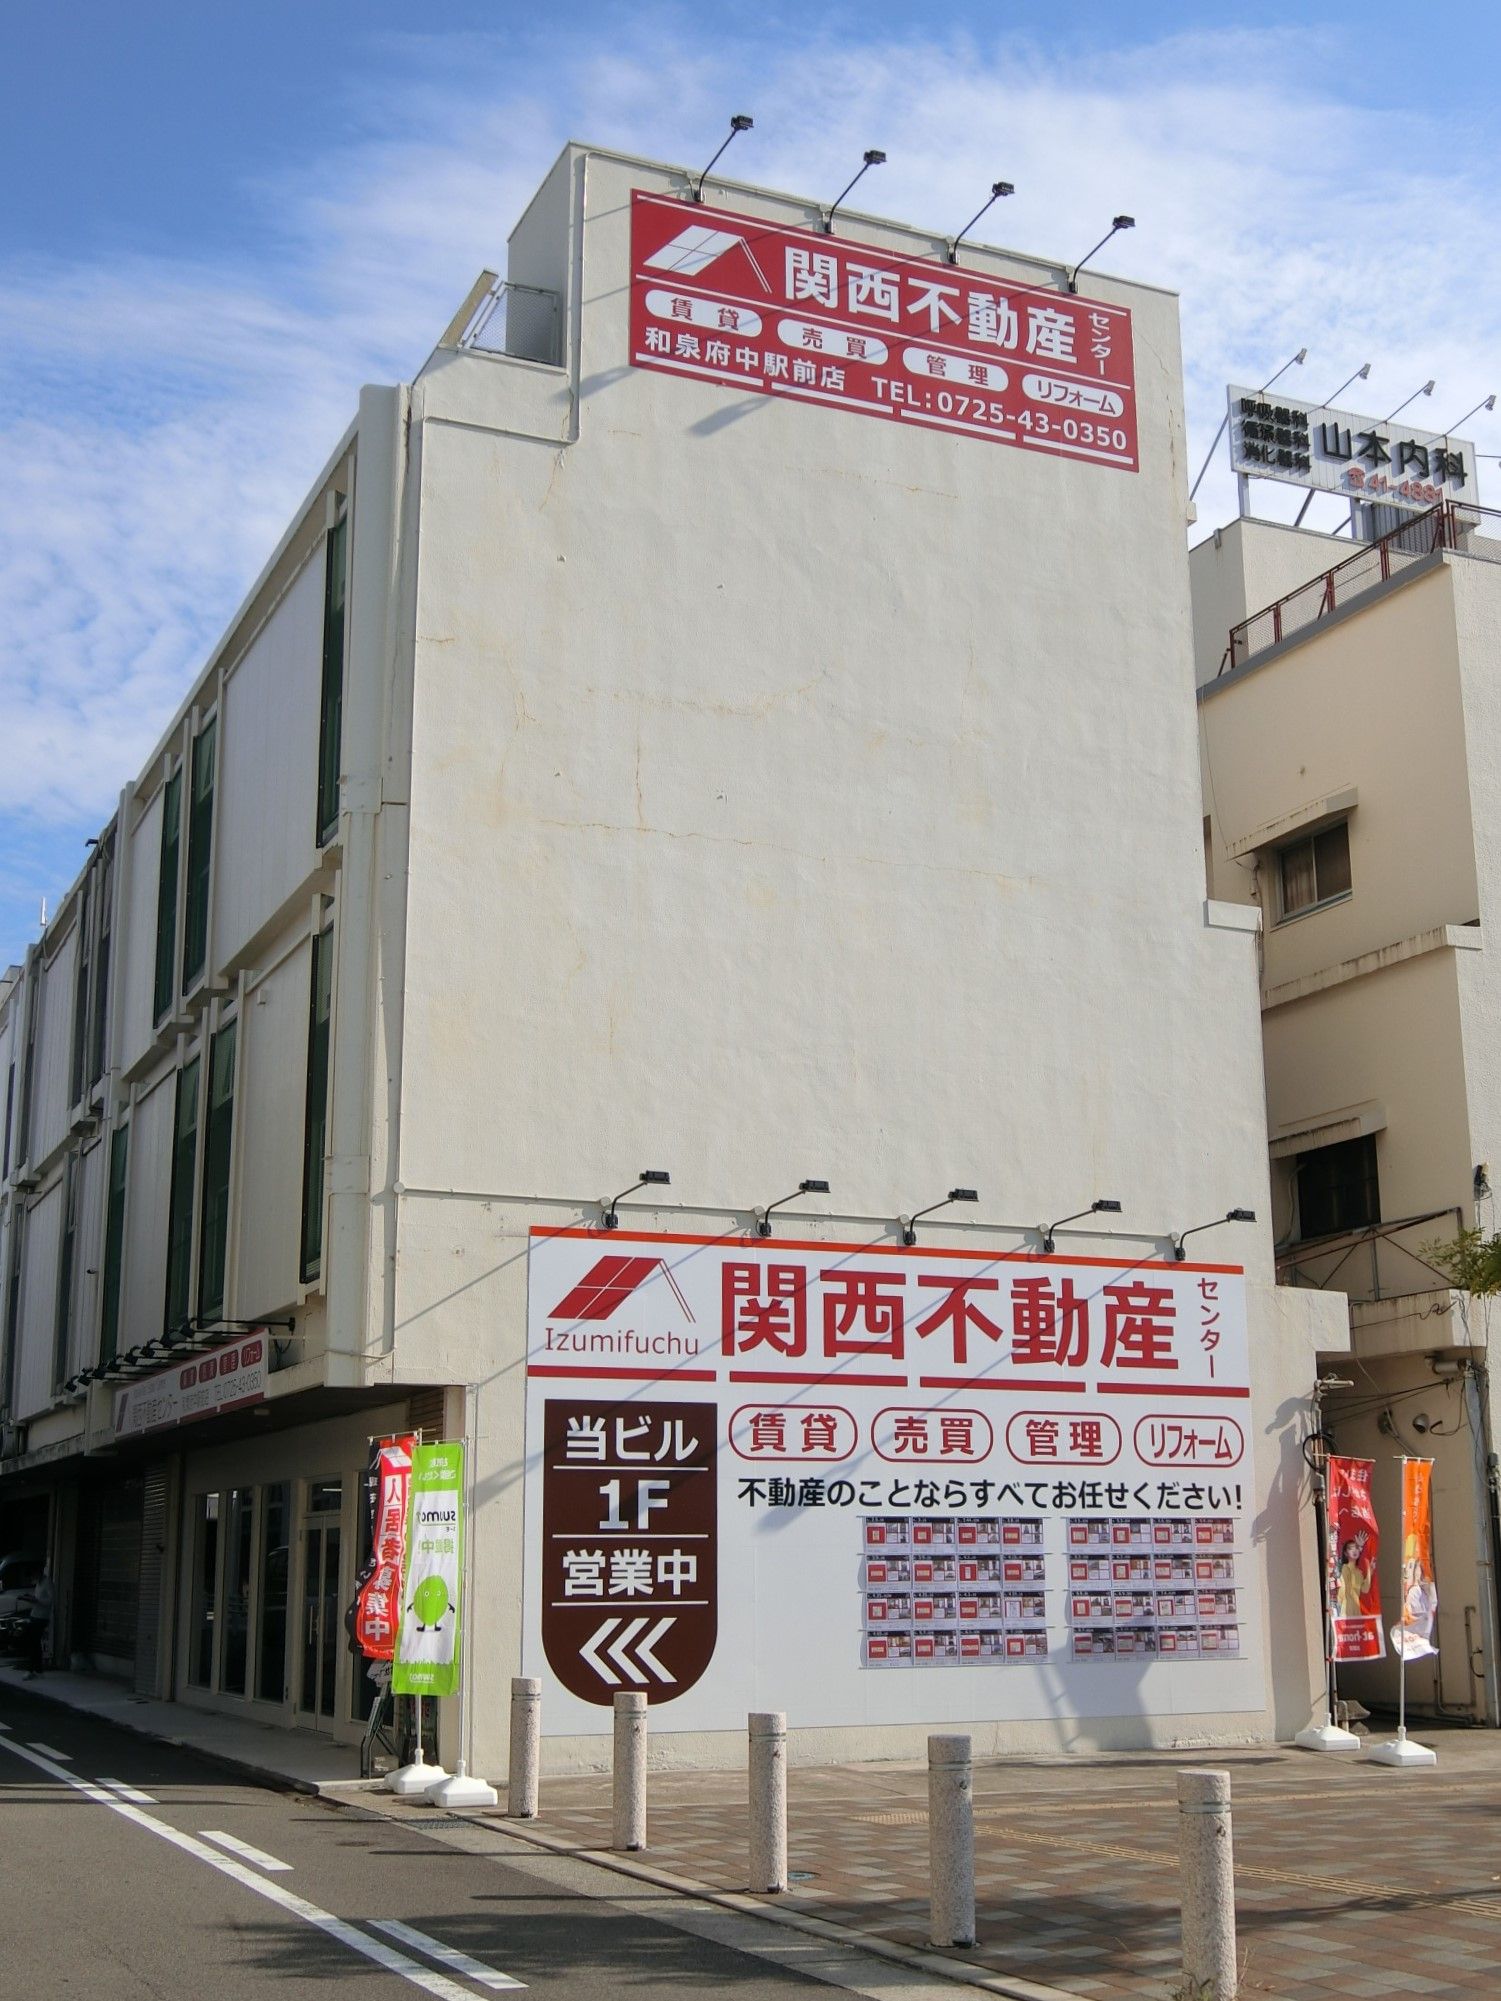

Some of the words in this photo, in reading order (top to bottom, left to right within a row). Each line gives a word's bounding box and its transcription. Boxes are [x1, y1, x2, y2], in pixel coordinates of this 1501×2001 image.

[670, 297, 740, 331] 賃貸
[784, 245, 1078, 364] 関西不動産
[645, 326, 845, 391] 和泉府中駅前店
[801, 328, 868, 359] 売買
[1088, 312, 1112, 375] センター
[926, 354, 989, 387] 管理
[870, 376, 1127, 451] TEL:0725-43-0350
[1037, 380, 1117, 415] リフォーム
[1320, 421, 1468, 487] 山本内科
[721, 1261, 1180, 1371] 関西不動産
[1196, 1277, 1221, 1379] センター
[545, 1327, 699, 1356] Izumifuchu
[564, 1414, 700, 1463] 当ビル
[749, 1413, 840, 1453] 賃貸
[894, 1417, 975, 1456] 売買
[1025, 1420, 1104, 1459] 管理
[1149, 1424, 1234, 1461] リフォーム
[598, 1480, 670, 1531] 1F
[737, 1478, 1243, 1513] 不動産のことならすべてお任せください!
[562, 1549, 698, 1597] 営業中
